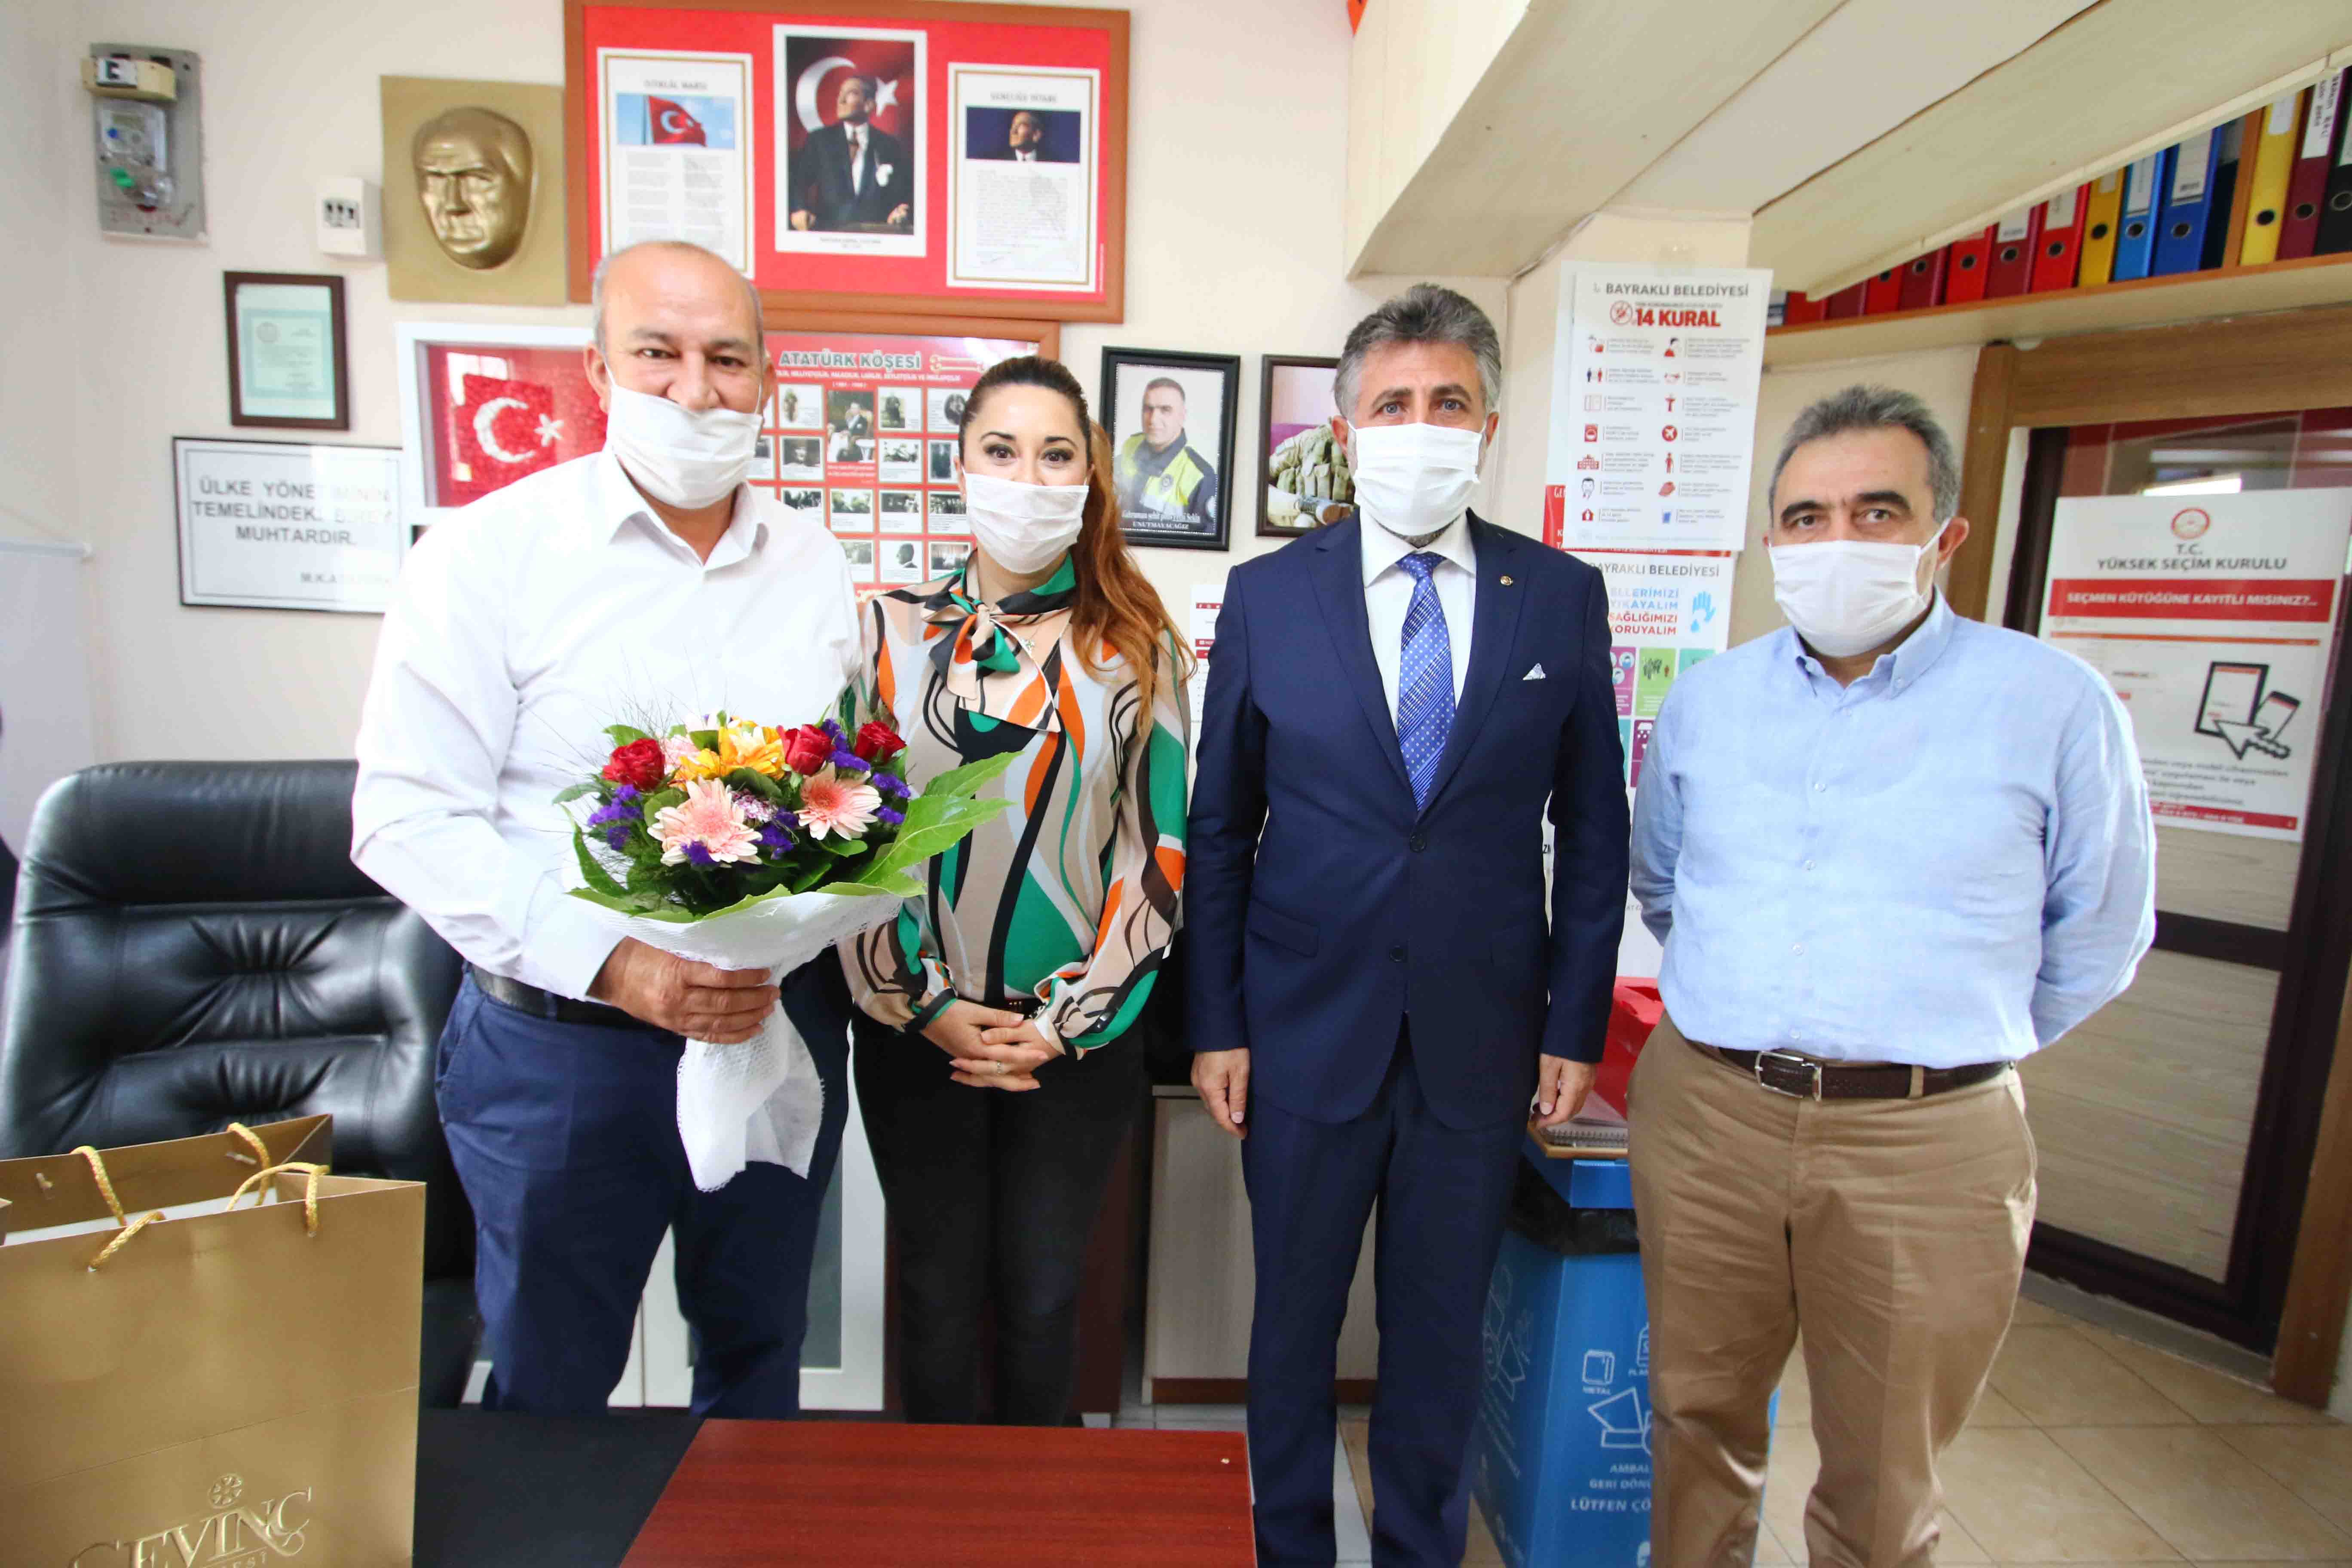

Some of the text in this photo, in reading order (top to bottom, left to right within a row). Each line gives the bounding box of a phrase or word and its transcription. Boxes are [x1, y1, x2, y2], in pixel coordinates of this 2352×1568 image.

[1606, 283, 1749, 297] BAYRAKLI BELEDİYESİ
[1636, 308, 1721, 327] 14 KURAL
[779, 349, 922, 374] ATATÜRK KÖŞESİ
[199, 475, 251, 496] ÜLKE
[192, 500, 323, 522] TEMELİNDEK
[236, 526, 357, 545] MUHTARDIR.
[2176, 543, 2204, 556] T.C.
[1649, 562, 1719, 577] BELEDİYESİ
[2098, 557, 2288, 572] YÜKSEK SEÇİM KURULU
[1611, 587, 1679, 598] ELLERİMİZİ
[2066, 592, 2116, 604] SEÇMEN
[2193, 593, 2244, 605] KAYITLI
[1610, 599, 1678, 609] YIKAYALIM
[1608, 610, 1678, 623] SAĞLIĞIMIZI
[1610, 1463, 1650, 1474] AMBAL
[1571, 1495, 1651, 1513] LÜTFEN ÇÖ
